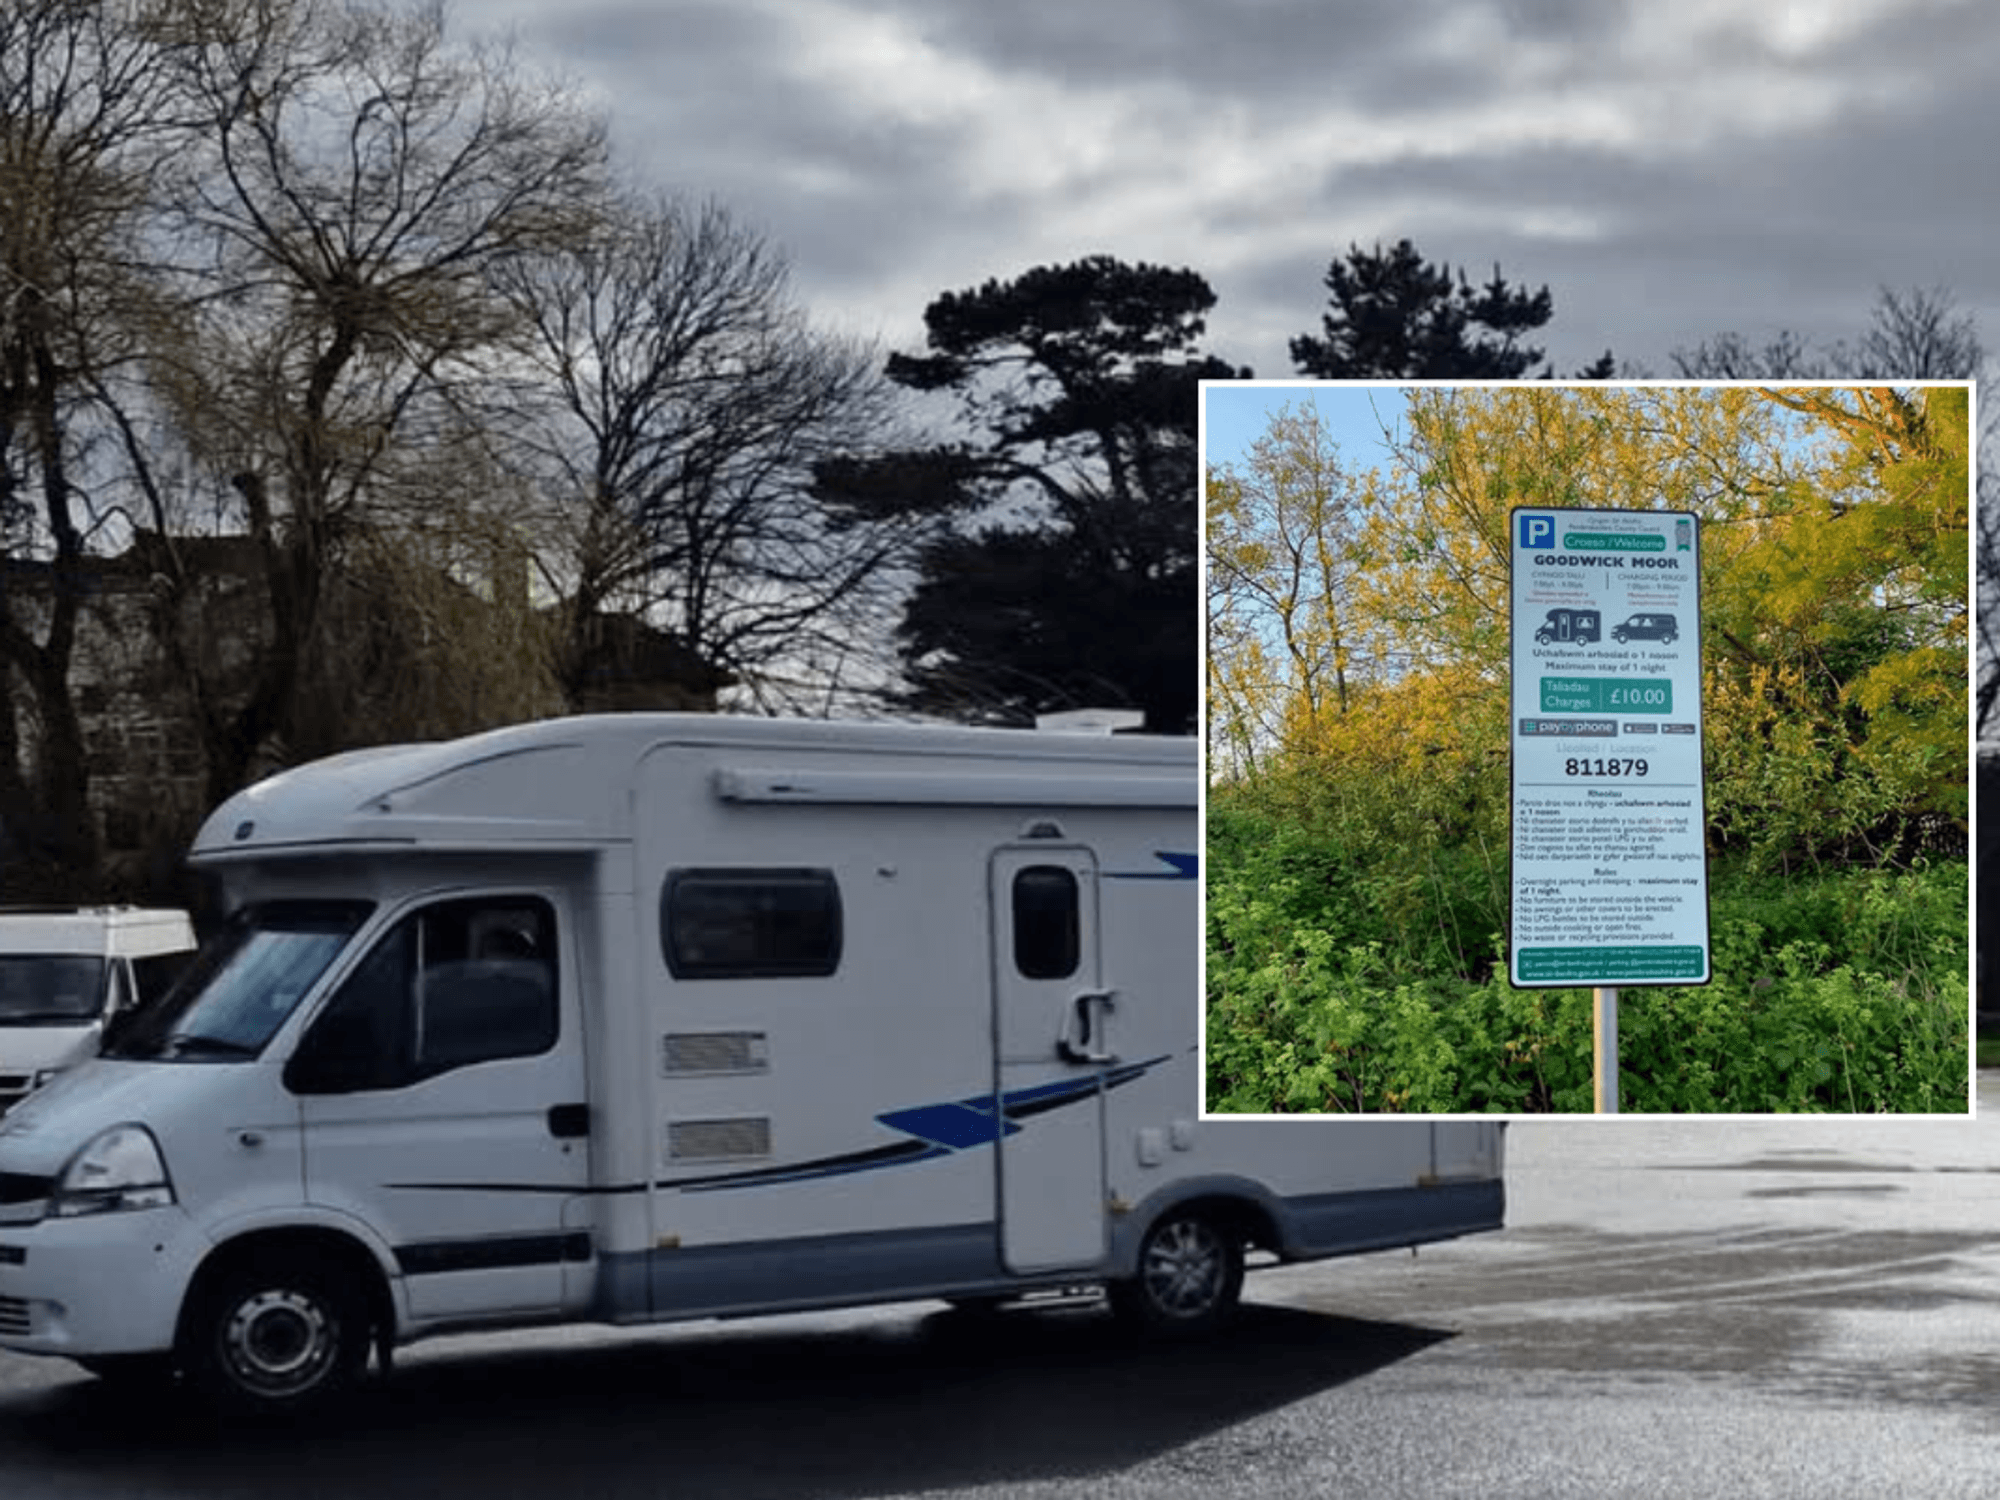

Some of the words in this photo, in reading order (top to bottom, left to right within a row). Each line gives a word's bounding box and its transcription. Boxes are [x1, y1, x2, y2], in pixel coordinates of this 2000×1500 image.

[1529, 519, 1550, 546] P
[1565, 535, 1605, 547] Croeso
[1612, 536, 1664, 549] Welcome
[1534, 555, 1624, 568] GOODWICK
[1632, 557, 1679, 569] MOOR
[1641, 651, 1646, 659] 1
[1545, 662, 1596, 670] Maximum
[1598, 664, 1618, 672] stay
[1640, 664, 1666, 673] night
[1544, 696, 1592, 710] Charges
[1610, 688, 1666, 704] £10.00
[1564, 758, 1649, 776] 811879
[1520, 877, 1557, 886] Overnight
[1559, 878, 1586, 886] parking
[1682, 878, 1699, 886] stay
